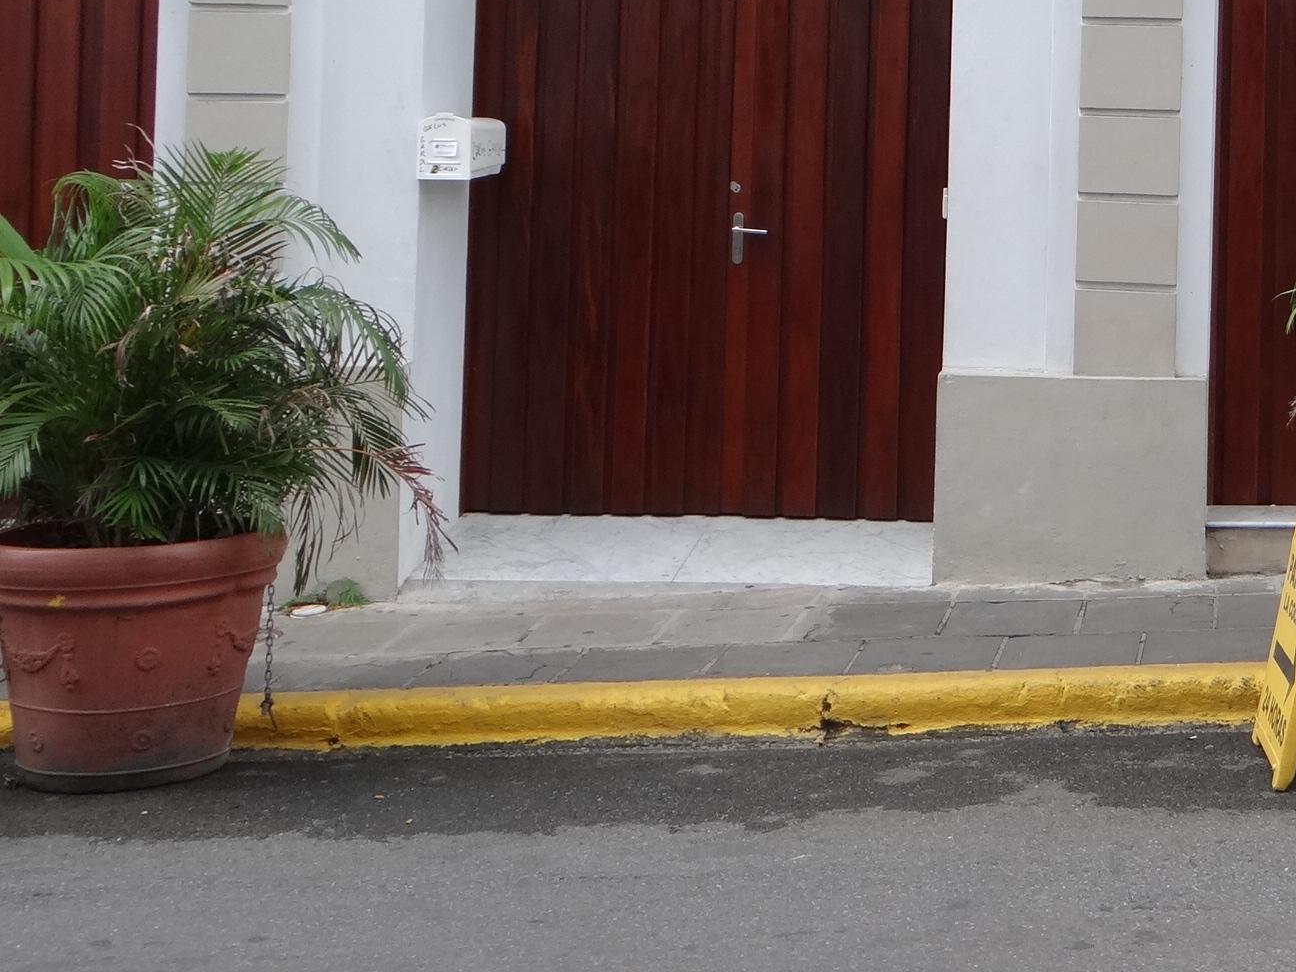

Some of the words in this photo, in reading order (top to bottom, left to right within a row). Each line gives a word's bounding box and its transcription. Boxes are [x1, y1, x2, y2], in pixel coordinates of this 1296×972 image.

[1283, 592, 1292, 617] LA
[1262, 685, 1272, 716] 24
[1267, 695, 1287, 747] HORAS
